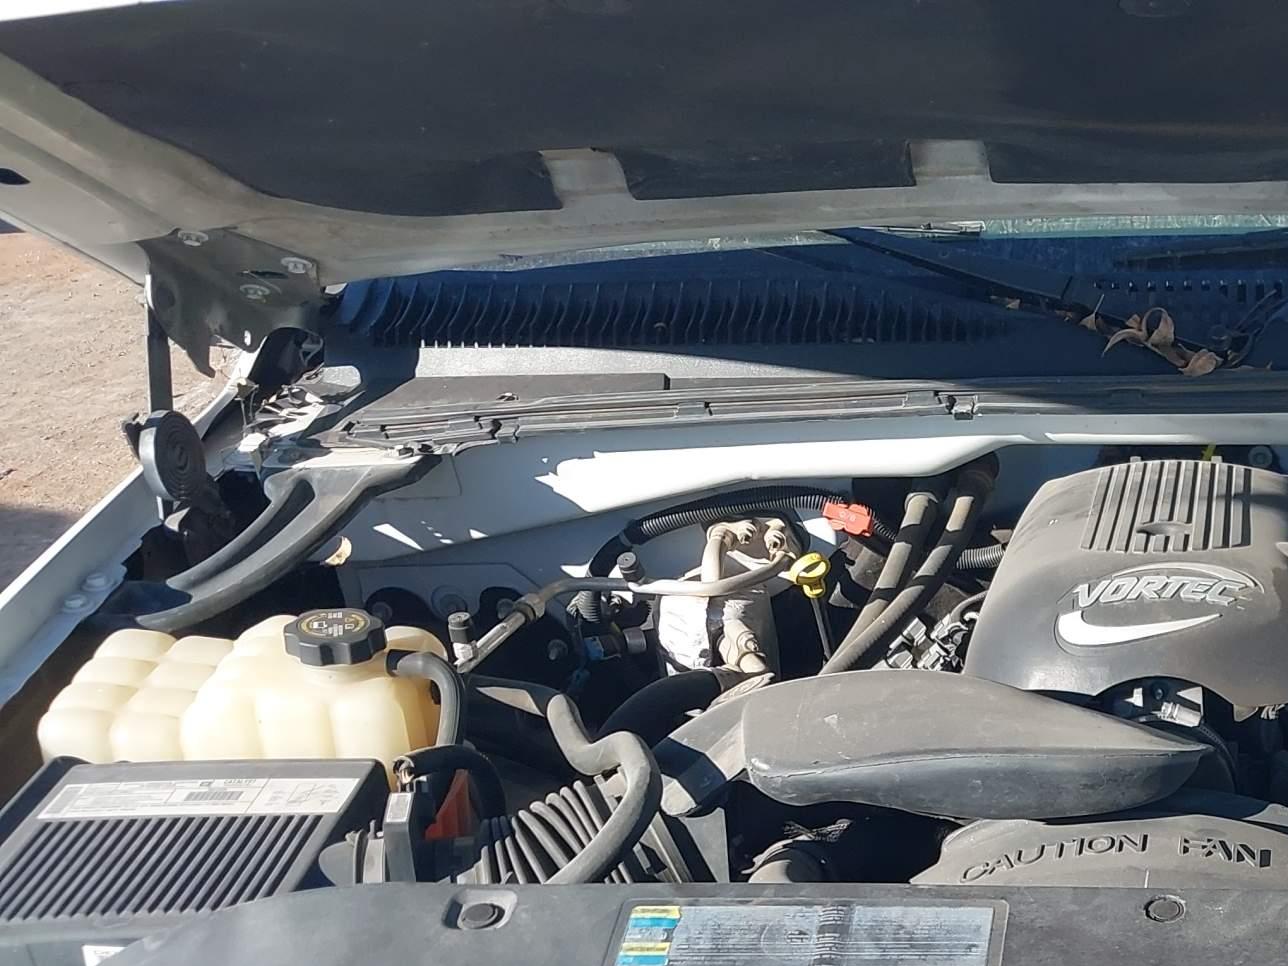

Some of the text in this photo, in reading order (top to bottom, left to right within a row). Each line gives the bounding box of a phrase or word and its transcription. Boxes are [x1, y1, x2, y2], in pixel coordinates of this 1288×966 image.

[1072, 575, 1247, 608] VORTEC
[960, 833, 1273, 883] CAUTION FAN
